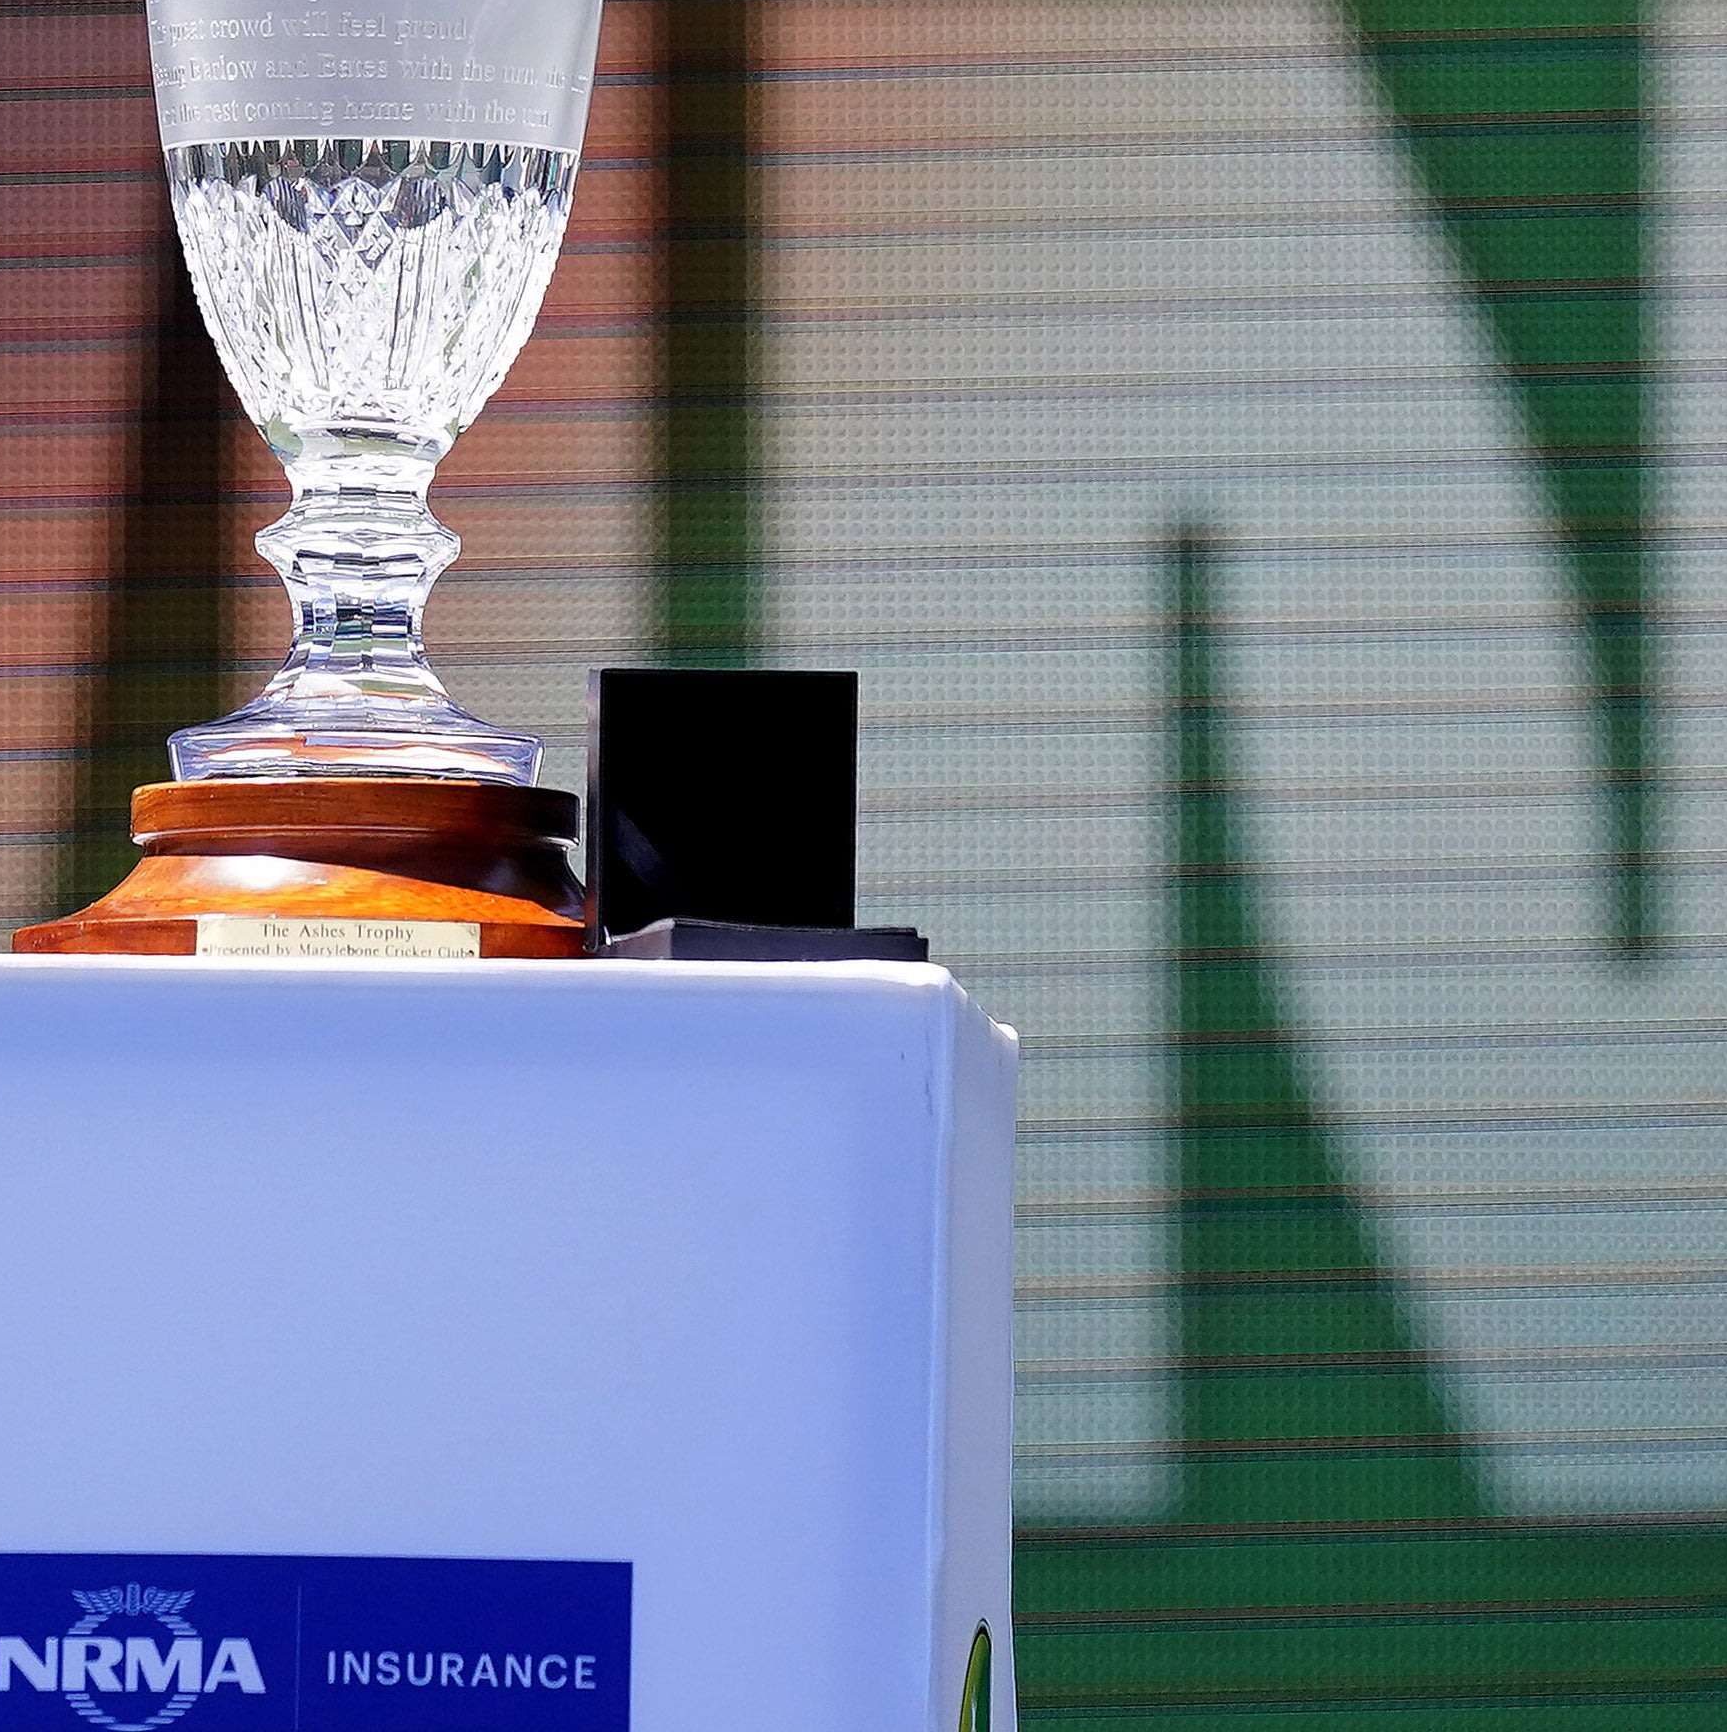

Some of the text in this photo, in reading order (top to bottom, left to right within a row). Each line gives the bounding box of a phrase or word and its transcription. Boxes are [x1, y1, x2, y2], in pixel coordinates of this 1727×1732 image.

[210, 11, 275, 39] crowd
[281, 10, 329, 37] will
[337, 11, 386, 37] feel
[188, 54, 257, 81] Barlow
[265, 53, 309, 79] and
[316, 52, 389, 79] Bates
[396, 54, 453, 81] with
[462, 56, 496, 82] the
[204, 99, 239, 124] rest
[244, 96, 335, 127] coming
[342, 94, 415, 121] home
[425, 99, 476, 124] with
[483, 99, 516, 124] the
[260, 923, 414, 943] The Ashes Trophy
[208, 943, 468, 959] Presented by Marylebone Cricket Club
[327, 1650, 597, 1690] INSURANCE
